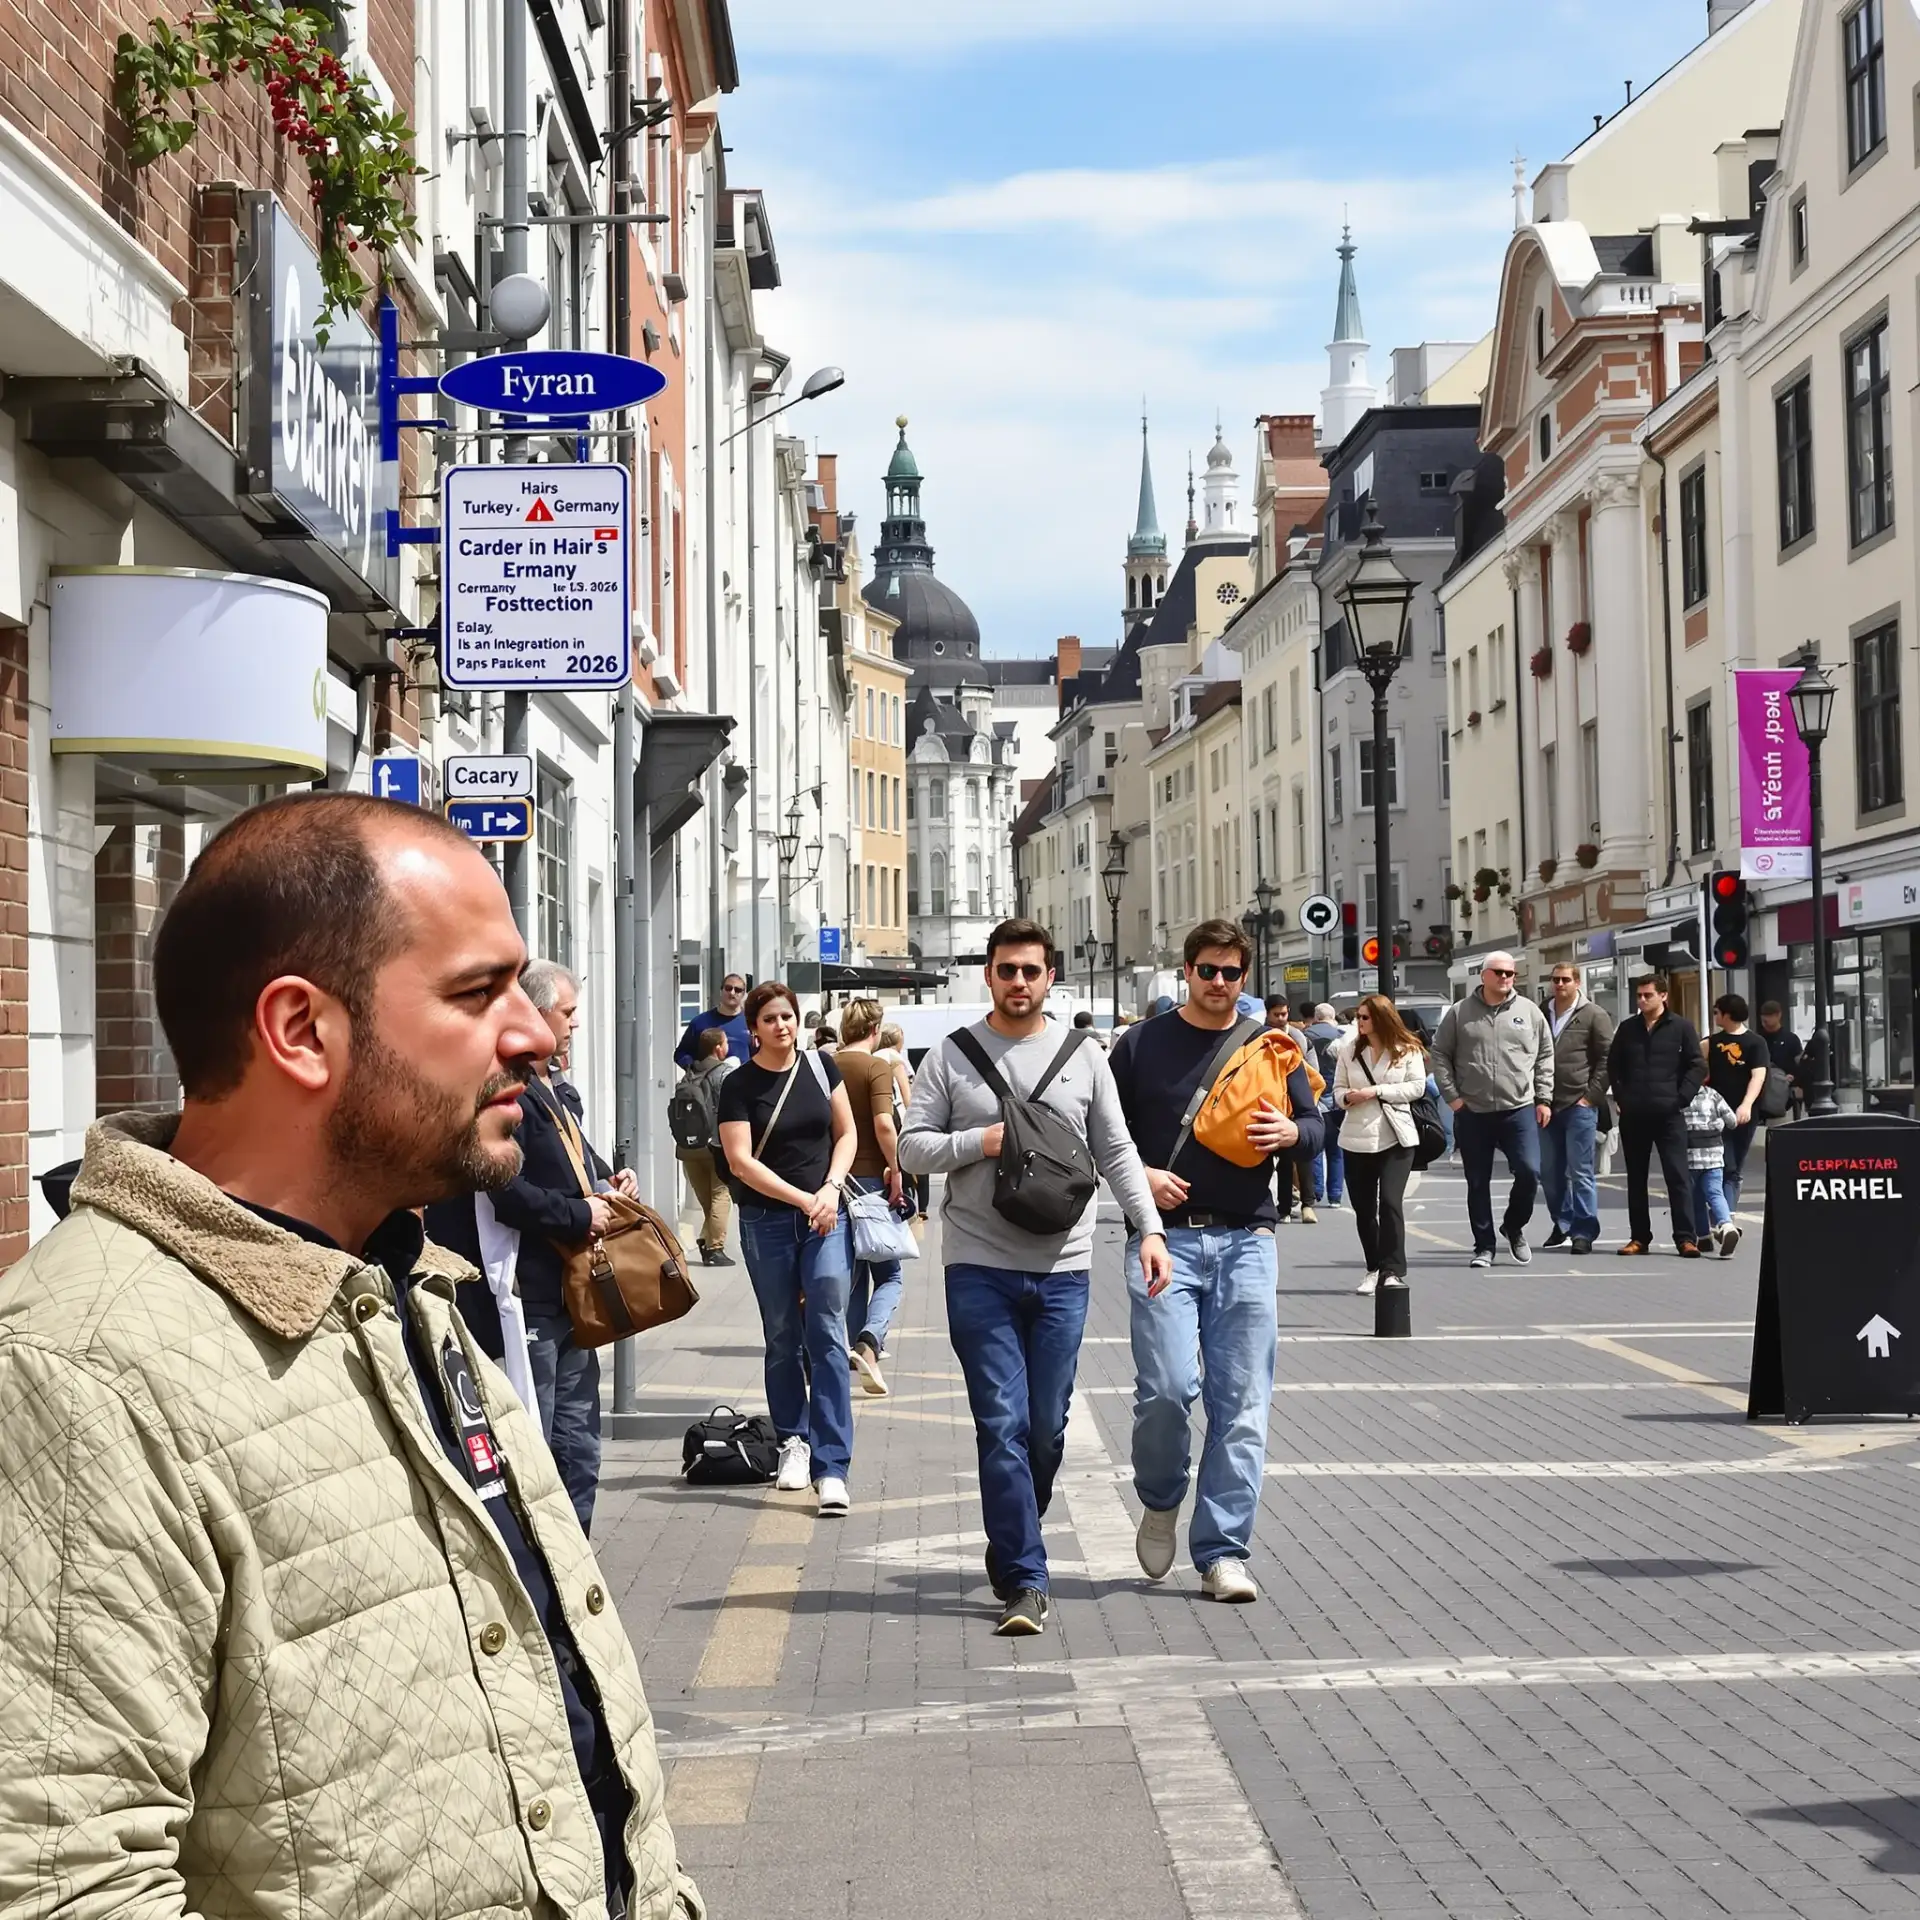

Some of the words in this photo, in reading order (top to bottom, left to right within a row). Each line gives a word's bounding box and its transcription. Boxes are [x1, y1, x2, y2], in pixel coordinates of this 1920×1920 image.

[501, 366, 597, 403] Fyran
[521, 482, 558, 495] Hairs
[554, 499, 620, 515] Germany
[459, 539, 523, 556] Carder
[529, 538, 546, 555] in
[503, 562, 577, 581] Ermany
[474, 641, 491, 650] an
[573, 637, 585, 649] in
[566, 655, 618, 673] 2026
[455, 767, 519, 787] Cacary
[1796, 1178, 1903, 1200] FARHEL
